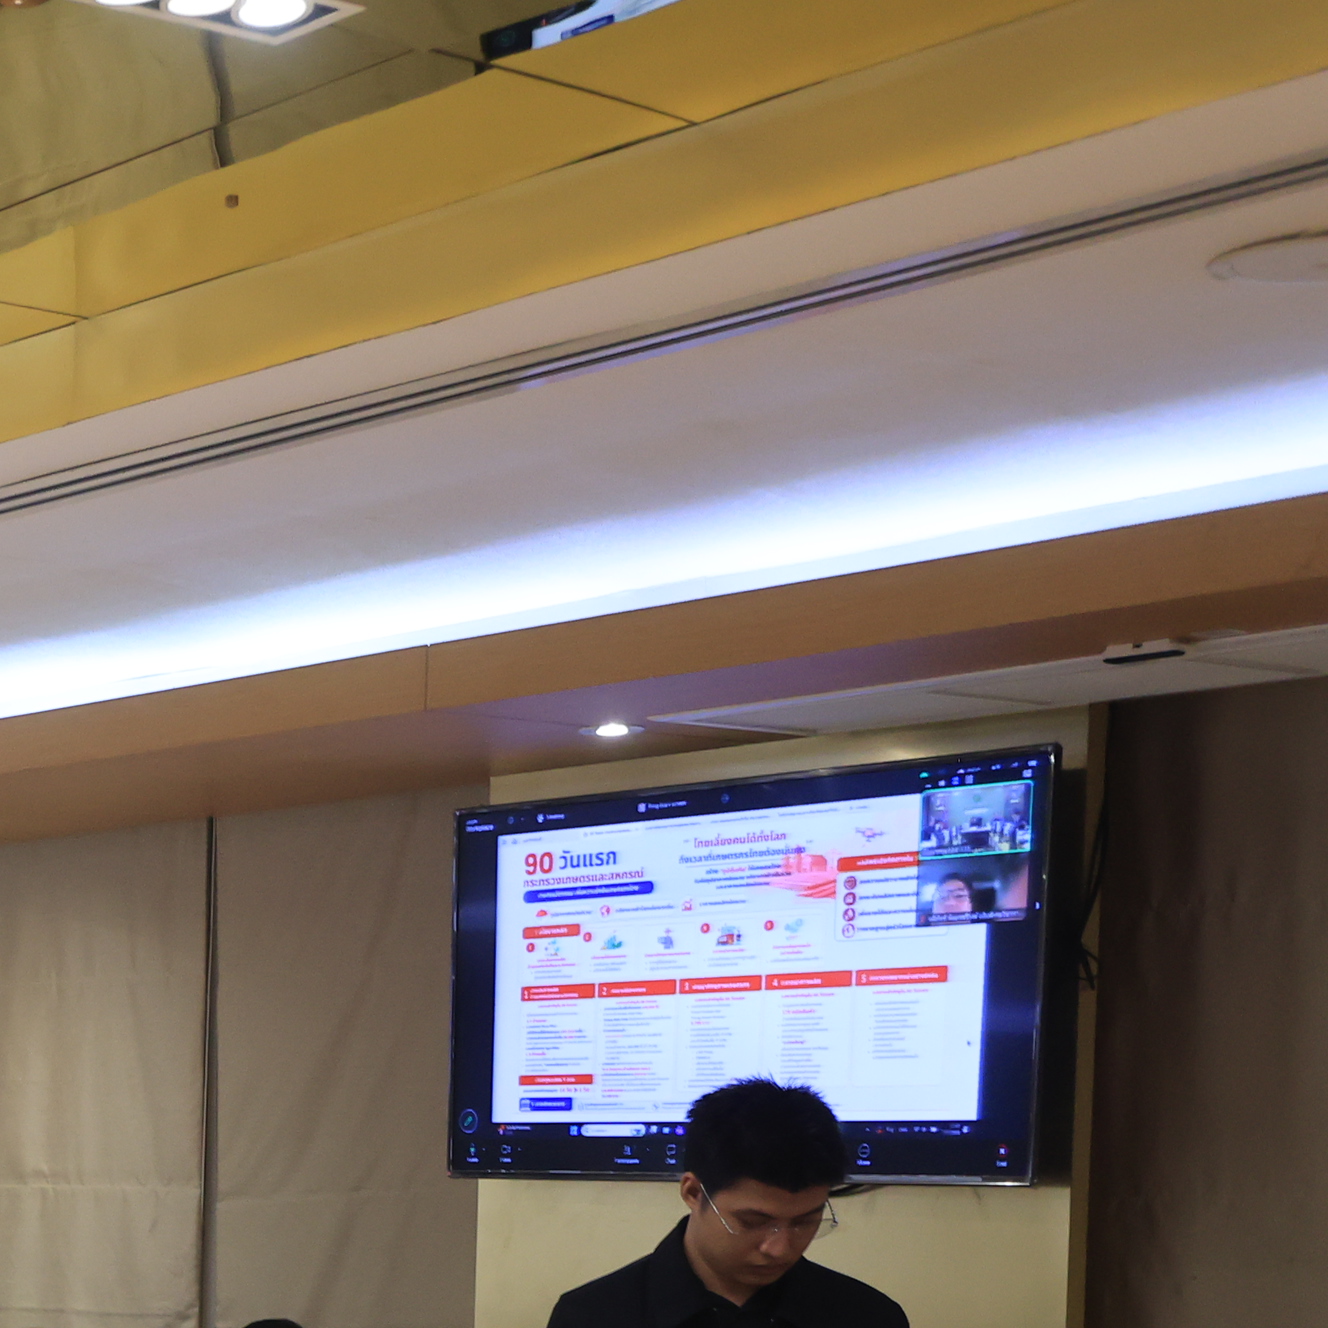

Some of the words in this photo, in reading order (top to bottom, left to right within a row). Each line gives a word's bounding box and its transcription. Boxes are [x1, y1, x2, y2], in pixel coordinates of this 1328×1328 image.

[524, 851, 554, 876] 90
[558, 850, 618, 871] วันแรก
[523, 868, 644, 889] กระทรวงเกษตรและสหกรณ์
